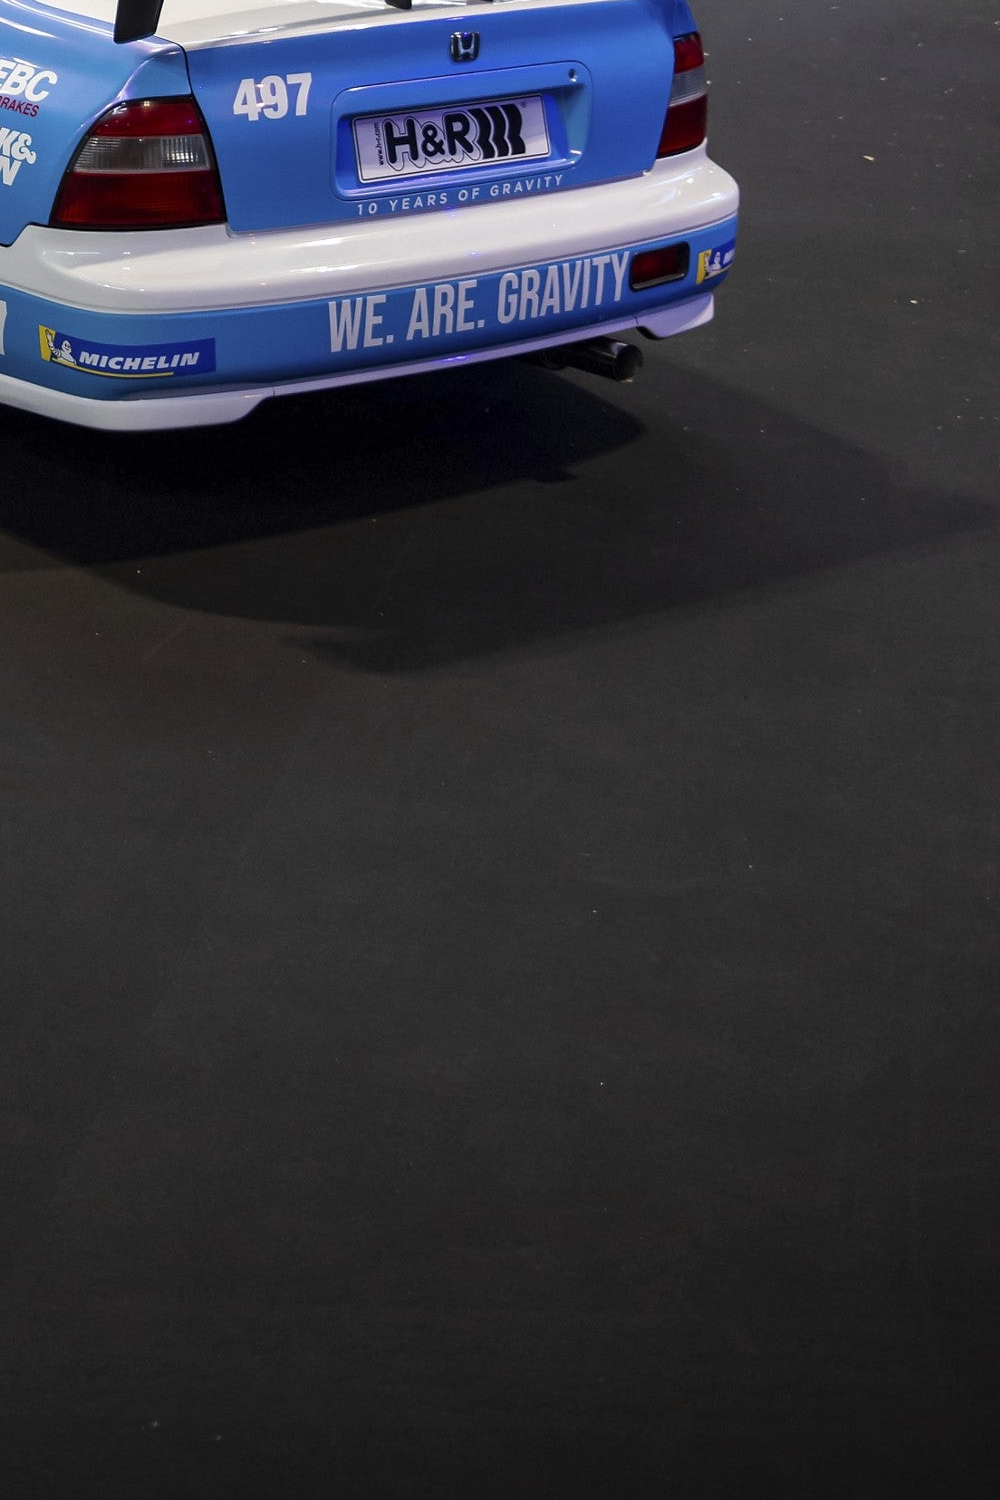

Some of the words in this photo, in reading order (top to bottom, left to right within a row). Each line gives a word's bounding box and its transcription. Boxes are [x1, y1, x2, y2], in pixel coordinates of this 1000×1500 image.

[232, 72, 313, 122] 497
[384, 112, 474, 165] H&R
[357, 202, 378, 216] 10
[389, 192, 448, 212] YEARS
[458, 187, 480, 202] OF
[490, 174, 564, 197] GRAVITY
[328, 294, 394, 353] WE.
[406, 279, 485, 341] ARE.
[498, 251, 631, 325] GRAVITY
[79, 350, 200, 371] MICHELIN
